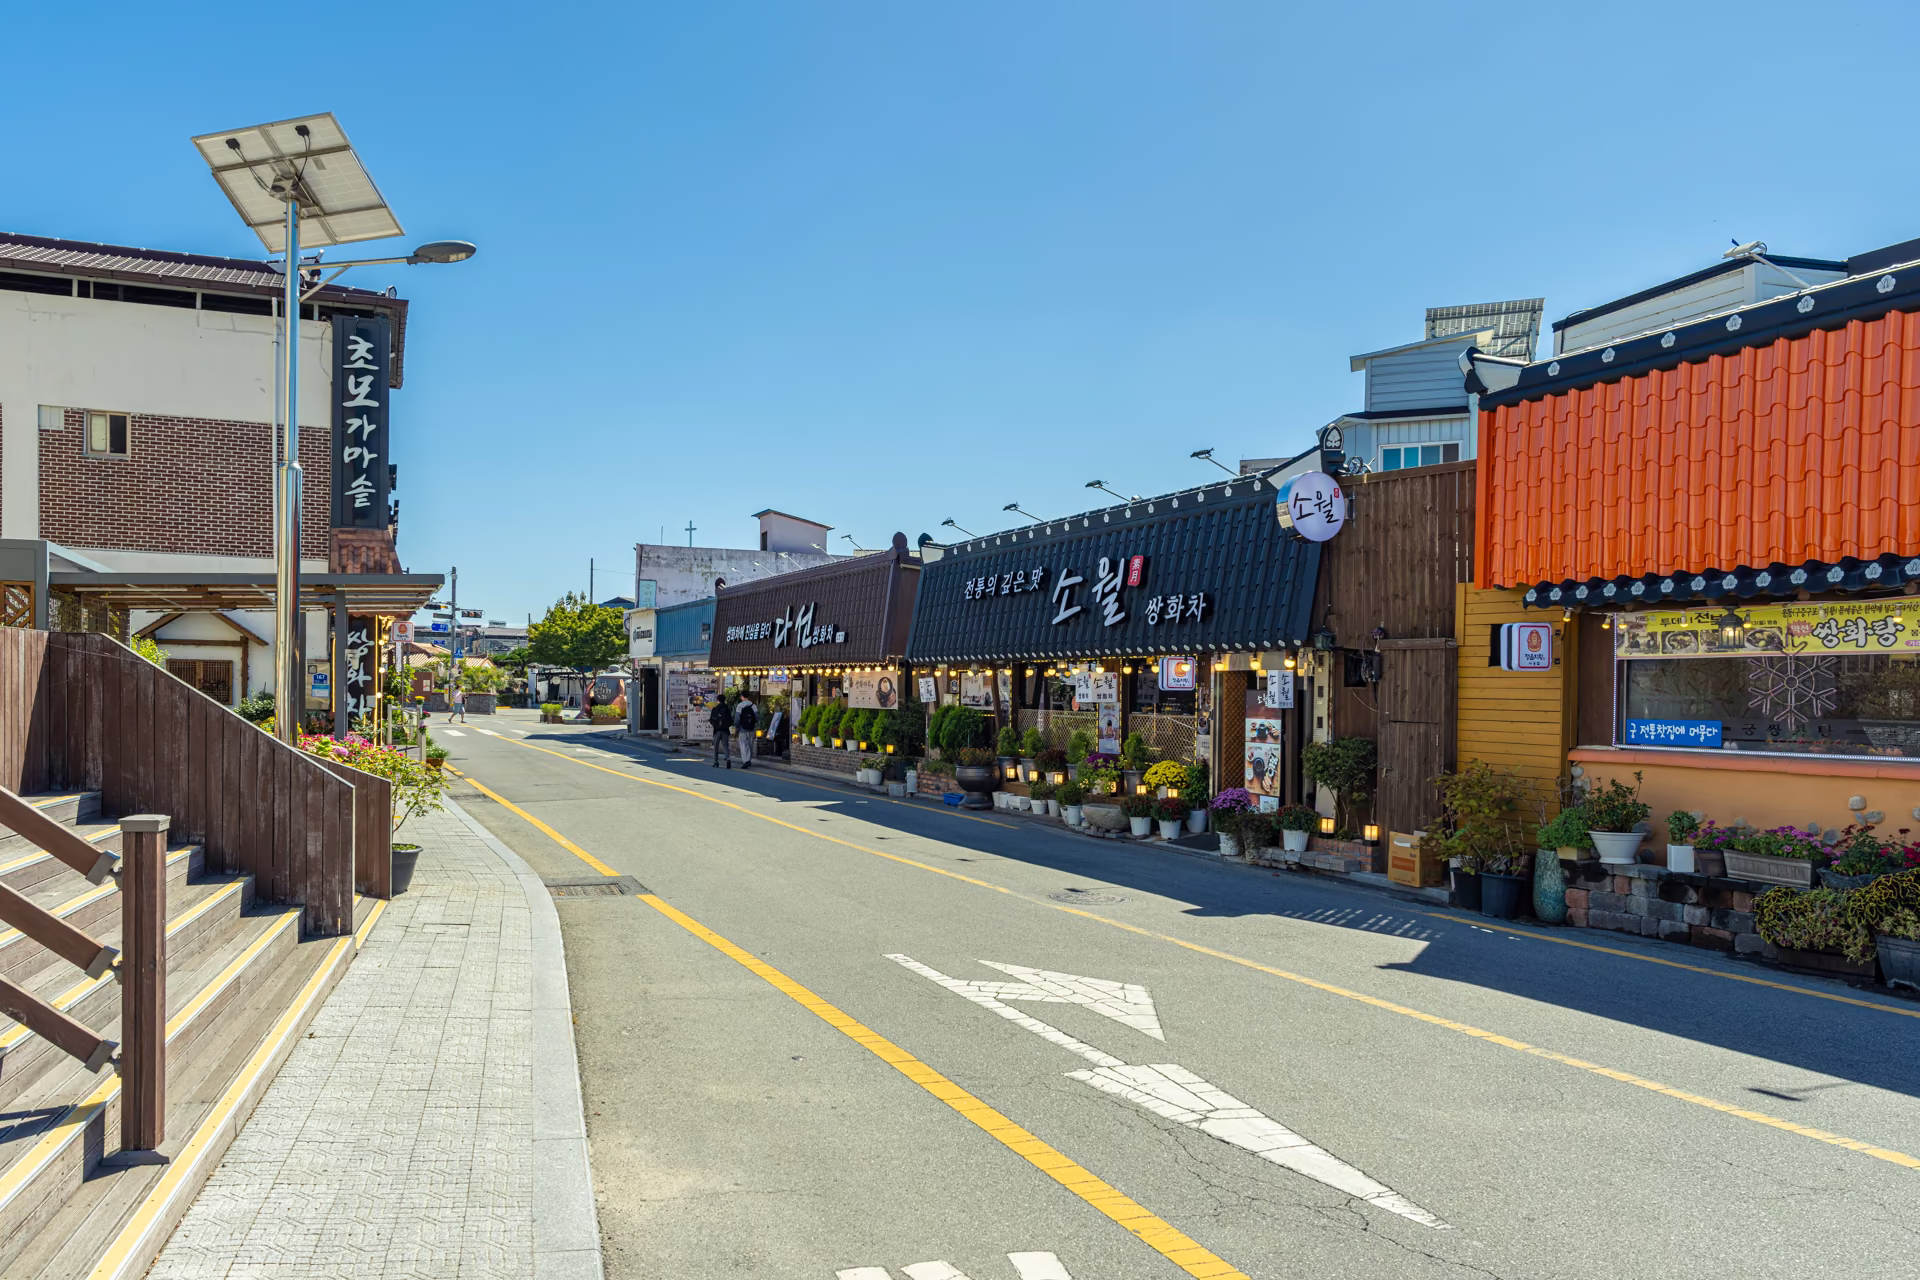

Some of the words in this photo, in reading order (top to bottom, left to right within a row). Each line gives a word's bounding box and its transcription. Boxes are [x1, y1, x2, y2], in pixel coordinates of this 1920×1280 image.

[342, 335, 380, 508] 초모가마솥
[1293, 491, 1340, 524] 소월
[963, 573, 998, 600] 전통의
[1000, 570, 1025, 595] 깊은
[1029, 566, 1044, 592] 맛
[1052, 556, 1125, 627] 소월
[1144, 592, 1207, 625] 쌍화차
[745, 622, 760, 640] 진심을
[760, 621, 772, 639] 담다
[812, 623, 834, 645] 쌍화차
[1811, 615, 1906, 649] 쌍화탕
[1077, 675, 1090, 690] 소월
[1093, 675, 1115, 690] 소월
[1281, 673, 1292, 701] 소월
[1630, 722, 1637, 739] 궁
[1640, 723, 1686, 740] 전통찻집에
[1689, 724, 1719, 743] 머물다
